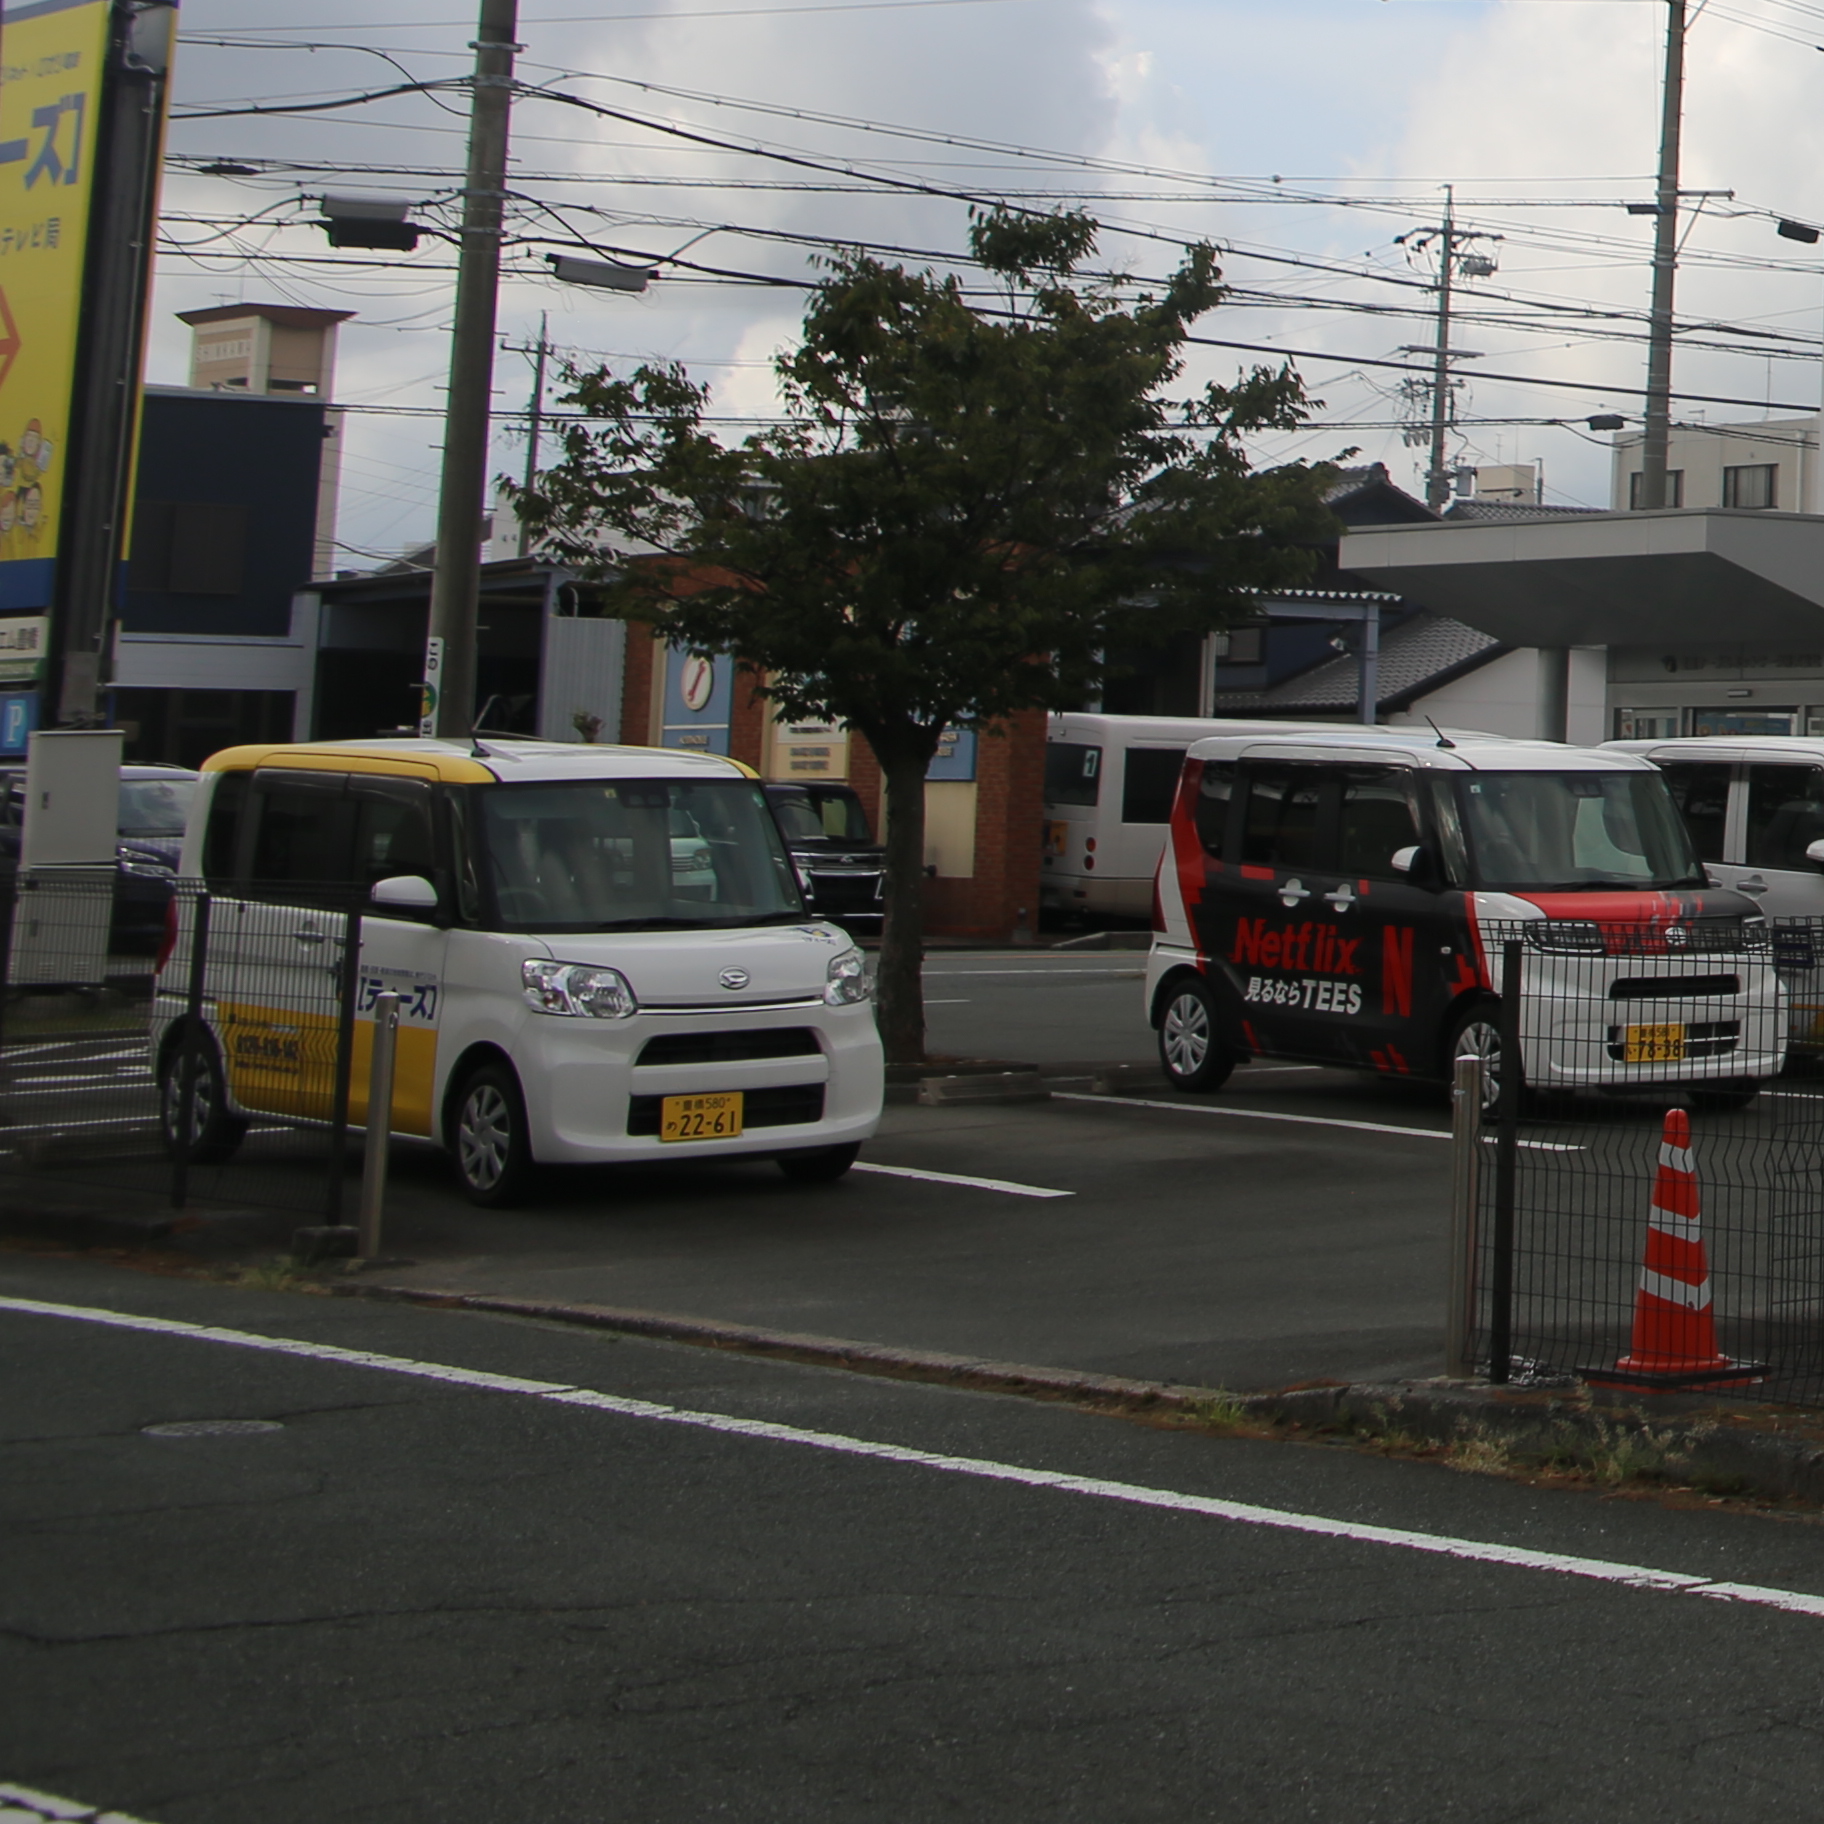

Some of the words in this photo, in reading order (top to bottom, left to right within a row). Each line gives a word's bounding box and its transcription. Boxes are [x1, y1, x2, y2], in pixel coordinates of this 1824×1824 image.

[6, 705, 23, 743] P
[1228, 917, 1364, 975] Netflix
[679, 1110, 736, 1137] 22-61
